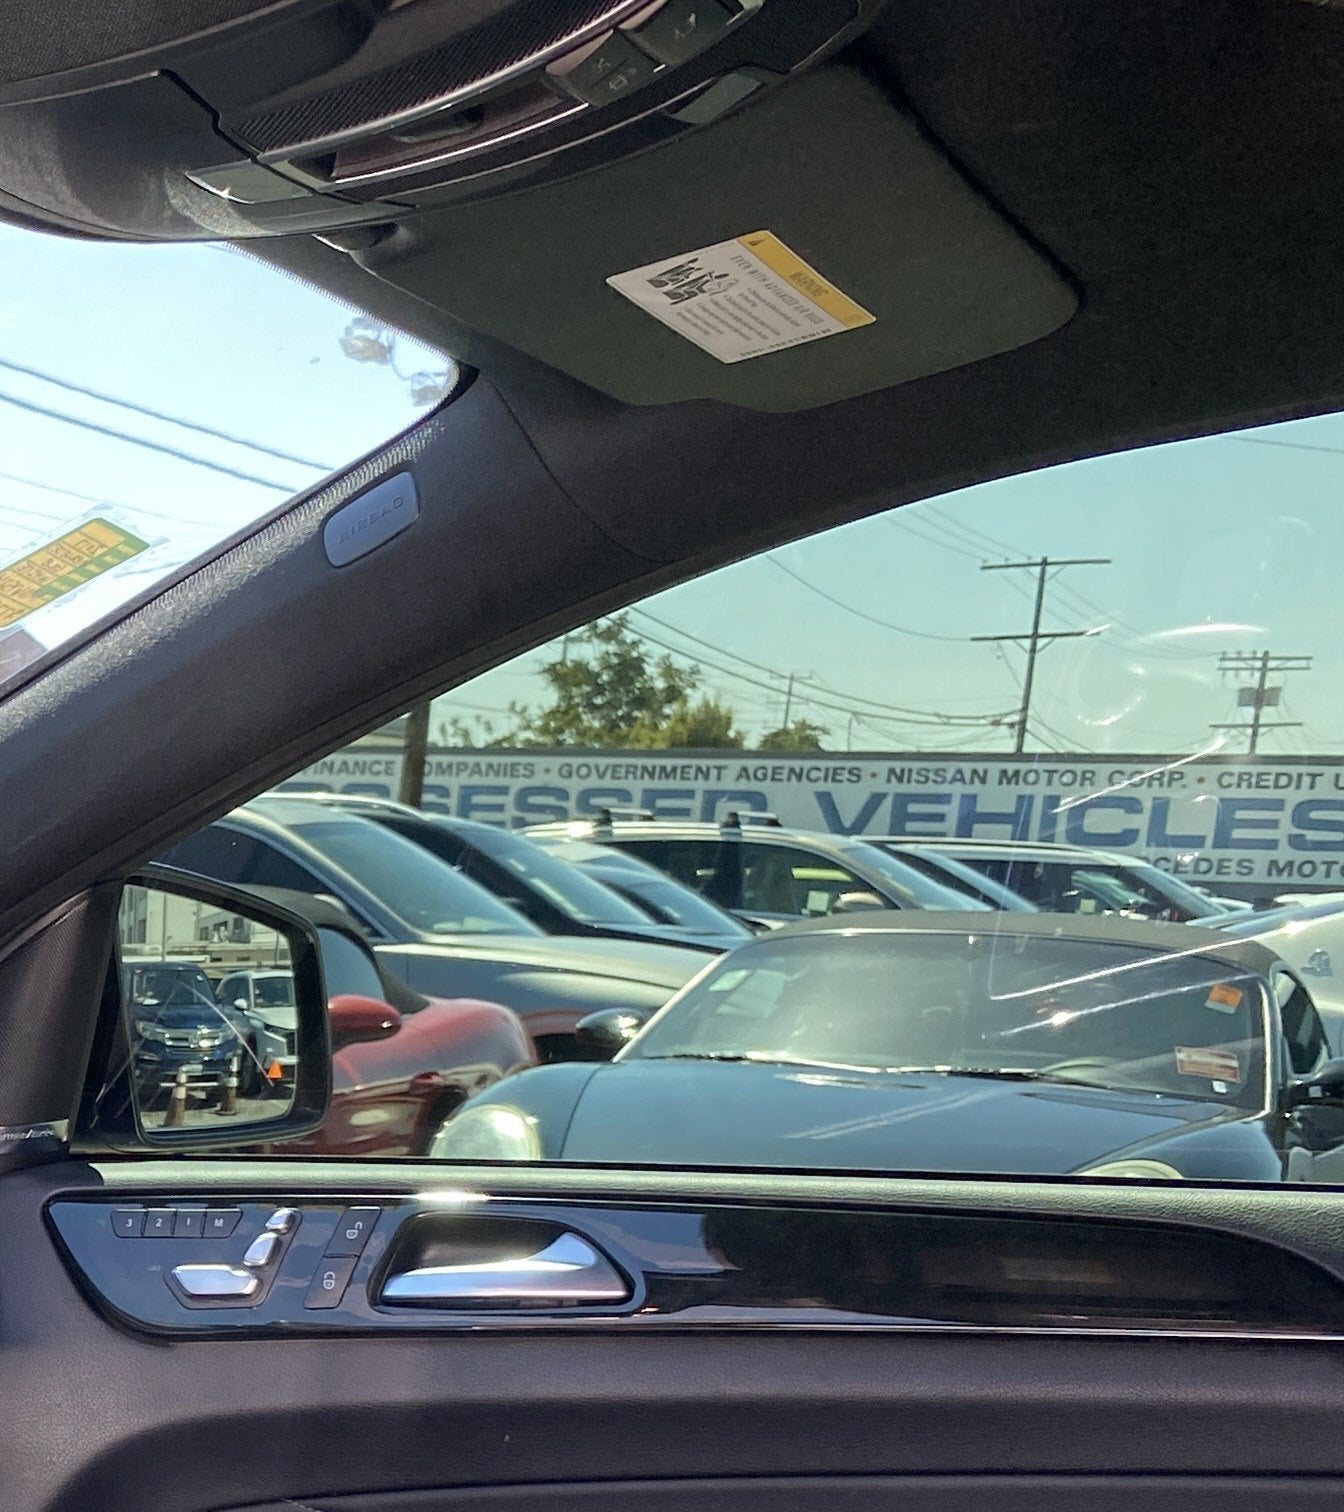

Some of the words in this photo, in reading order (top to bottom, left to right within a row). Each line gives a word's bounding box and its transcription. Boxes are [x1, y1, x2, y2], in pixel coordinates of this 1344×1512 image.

[303, 759, 395, 777] INANCE
[423, 761, 535, 779] OMPANIES
[559, 763, 731, 782] GOVERNMENT
[736, 765, 862, 784] AGENCIES
[886, 767, 989, 786] NISSAN
[998, 768, 1097, 787] MOTOR
[1217, 771, 1324, 790] CREDIT
[815, 790, 1344, 852] VEHICLES
[1137, 856, 1255, 877] CEDES
[125, 1219, 133, 1228] 3
[155, 1218, 163, 1228] 2
